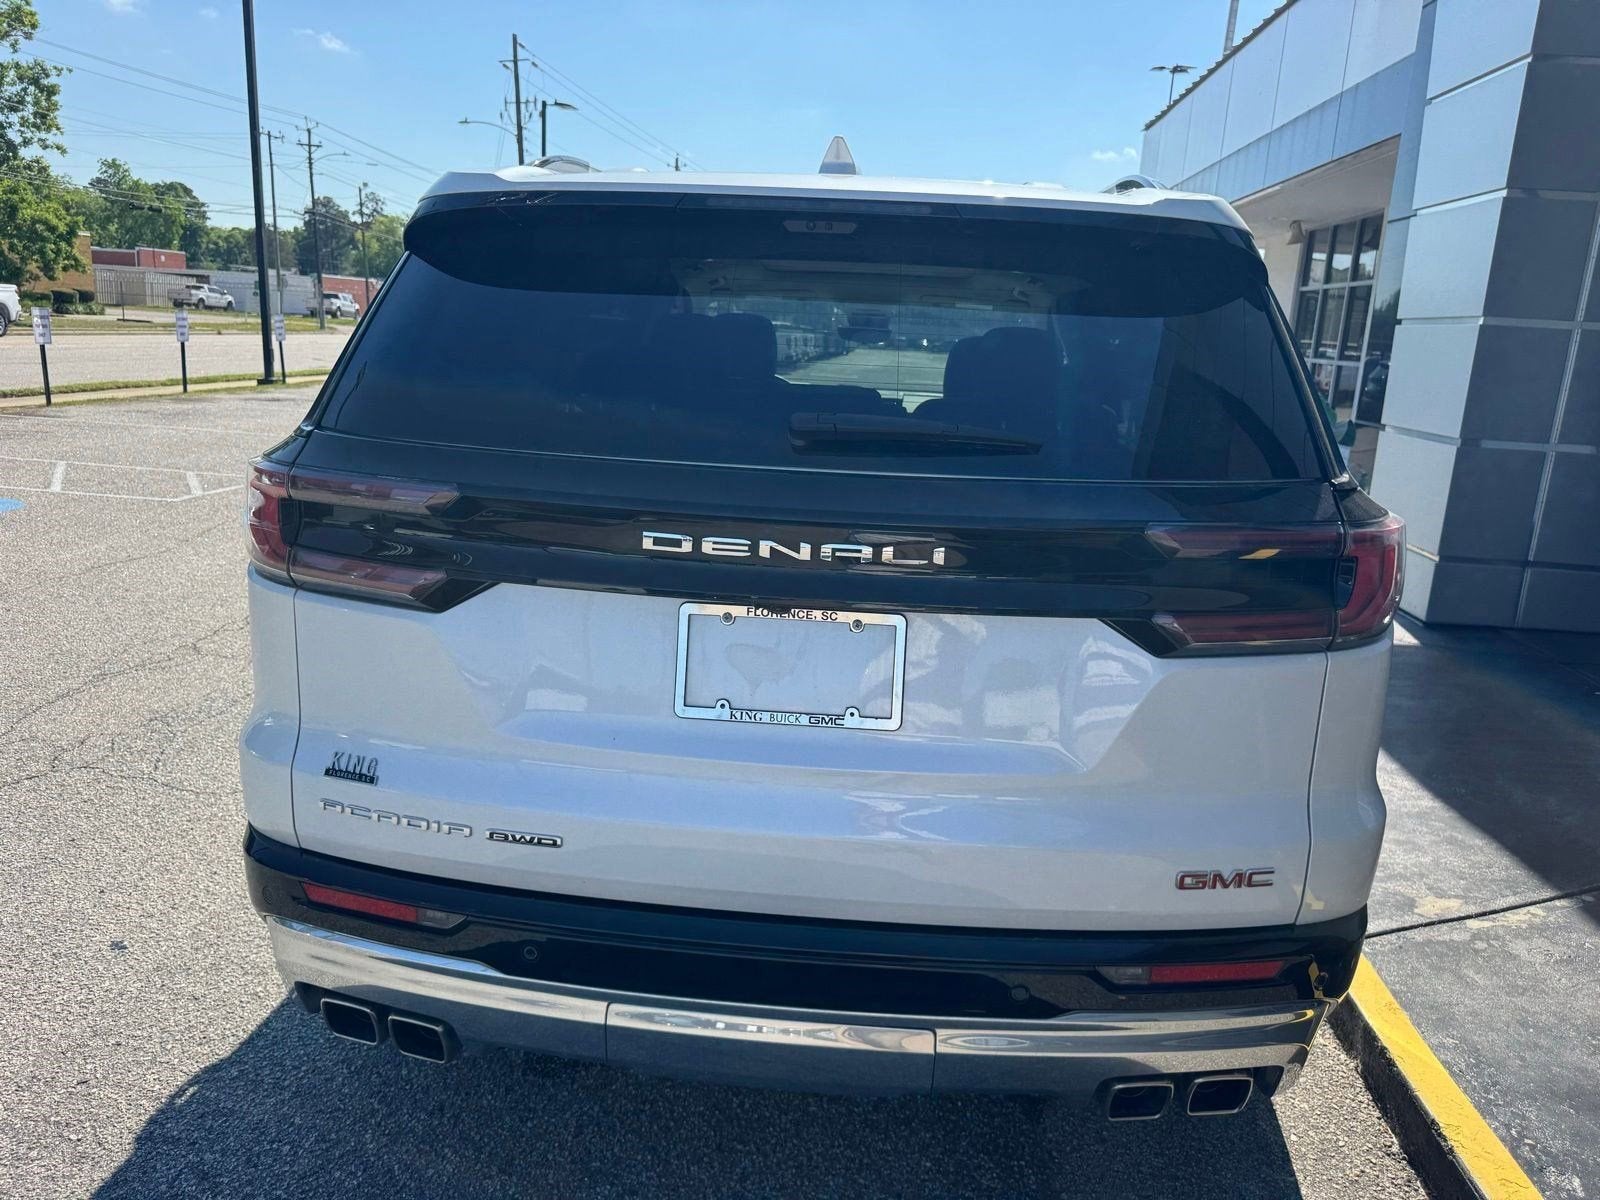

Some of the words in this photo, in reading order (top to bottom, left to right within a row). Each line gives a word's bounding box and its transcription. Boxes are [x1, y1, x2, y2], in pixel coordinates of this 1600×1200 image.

[642, 531, 945, 566] DENALI
[821, 611, 838, 621] SC
[729, 711, 763, 722] KING
[769, 714, 801, 724] BUICK
[808, 716, 845, 726] GMC
[331, 751, 378, 777] KING
[319, 798, 473, 838] ACADIA
[488, 831, 559, 847] AWD
[1175, 867, 1275, 890] GMC
